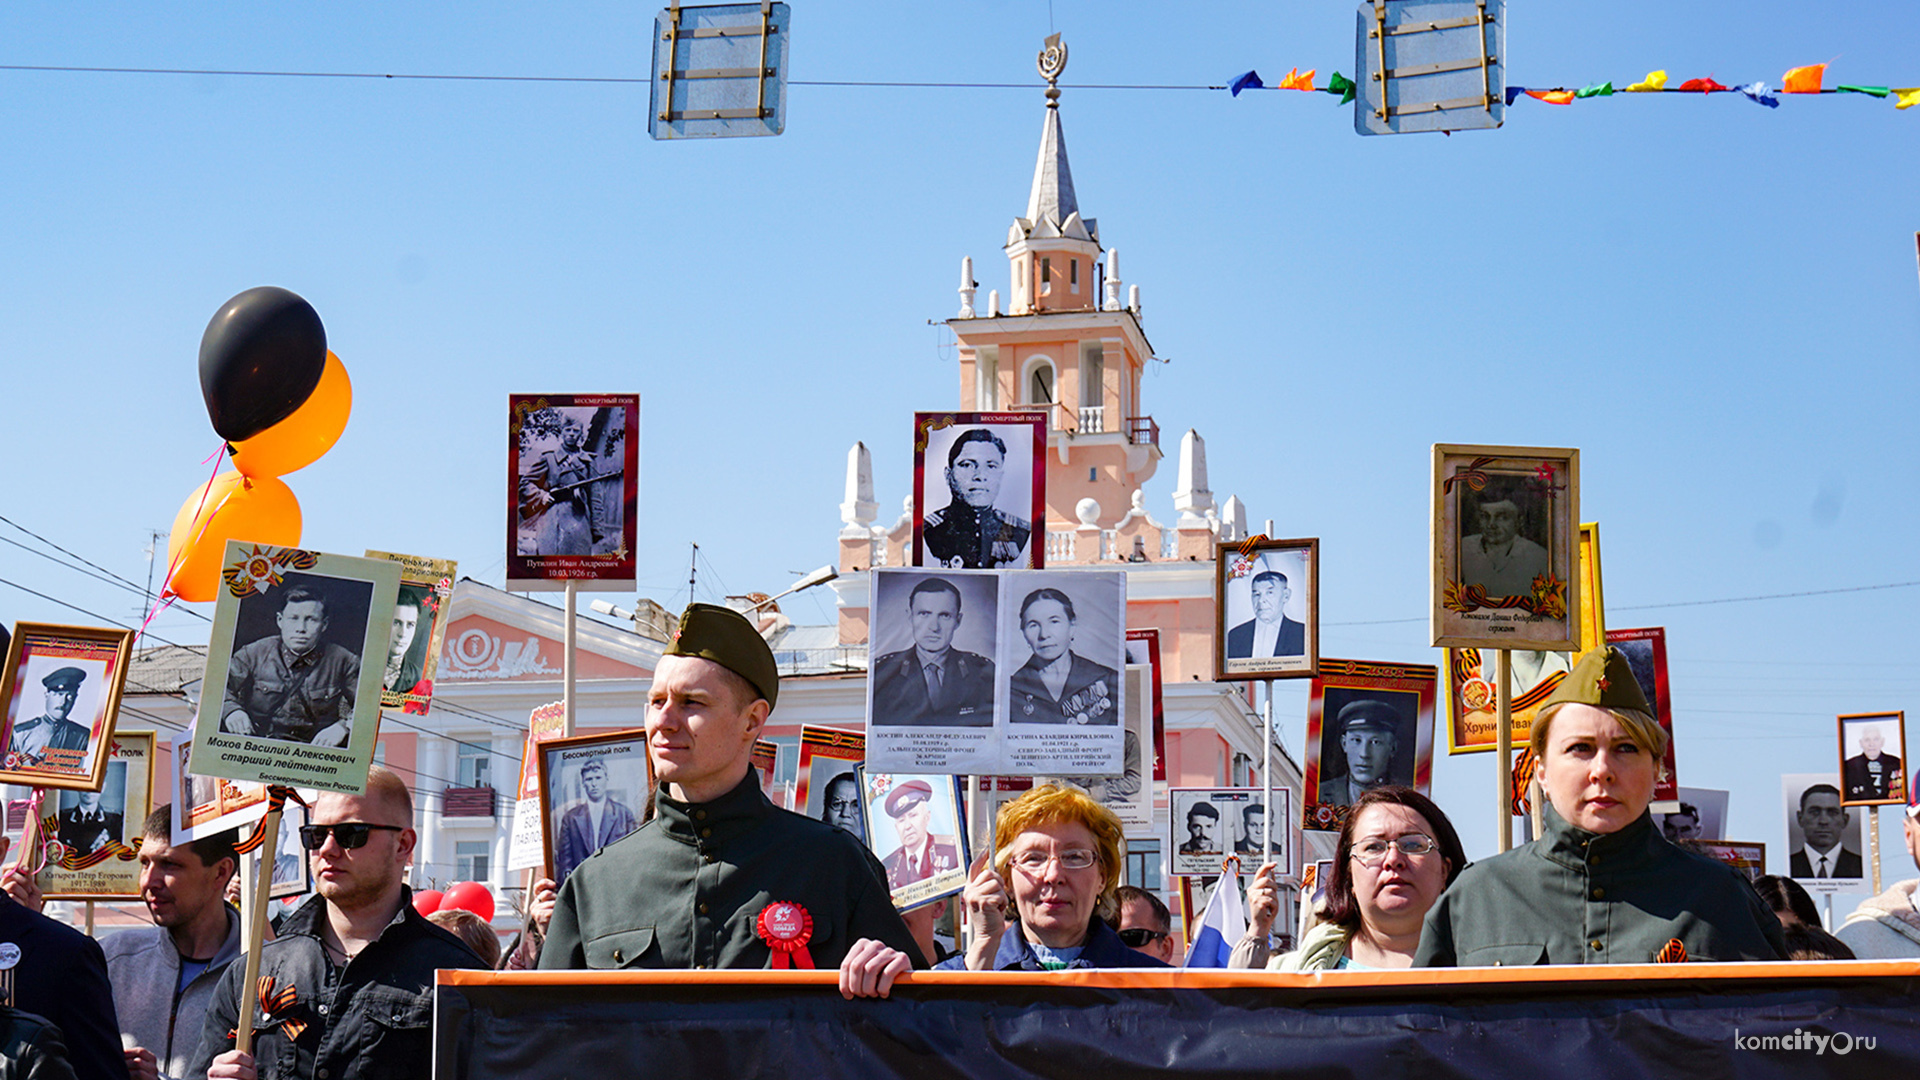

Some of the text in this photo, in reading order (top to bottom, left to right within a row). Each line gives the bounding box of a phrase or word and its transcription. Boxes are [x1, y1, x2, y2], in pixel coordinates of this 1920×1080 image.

[526, 560, 557, 569] Путилин
[579, 560, 619, 569] Андреевич
[548, 569, 585, 577] 10.03.1926
[49, 636, 58, 648] 9
[1345, 661, 1405, 677] 9 мая
[1465, 721, 1497, 734] Хруни
[832, 733, 842, 745] 9
[207, 736, 356, 764] Мохов Василий Алексеевич
[562, 746, 631, 760] Бессмертный полк
[221, 752, 338, 775] старший лейтенант
[259, 772, 360, 792] Бессмертный полк России
